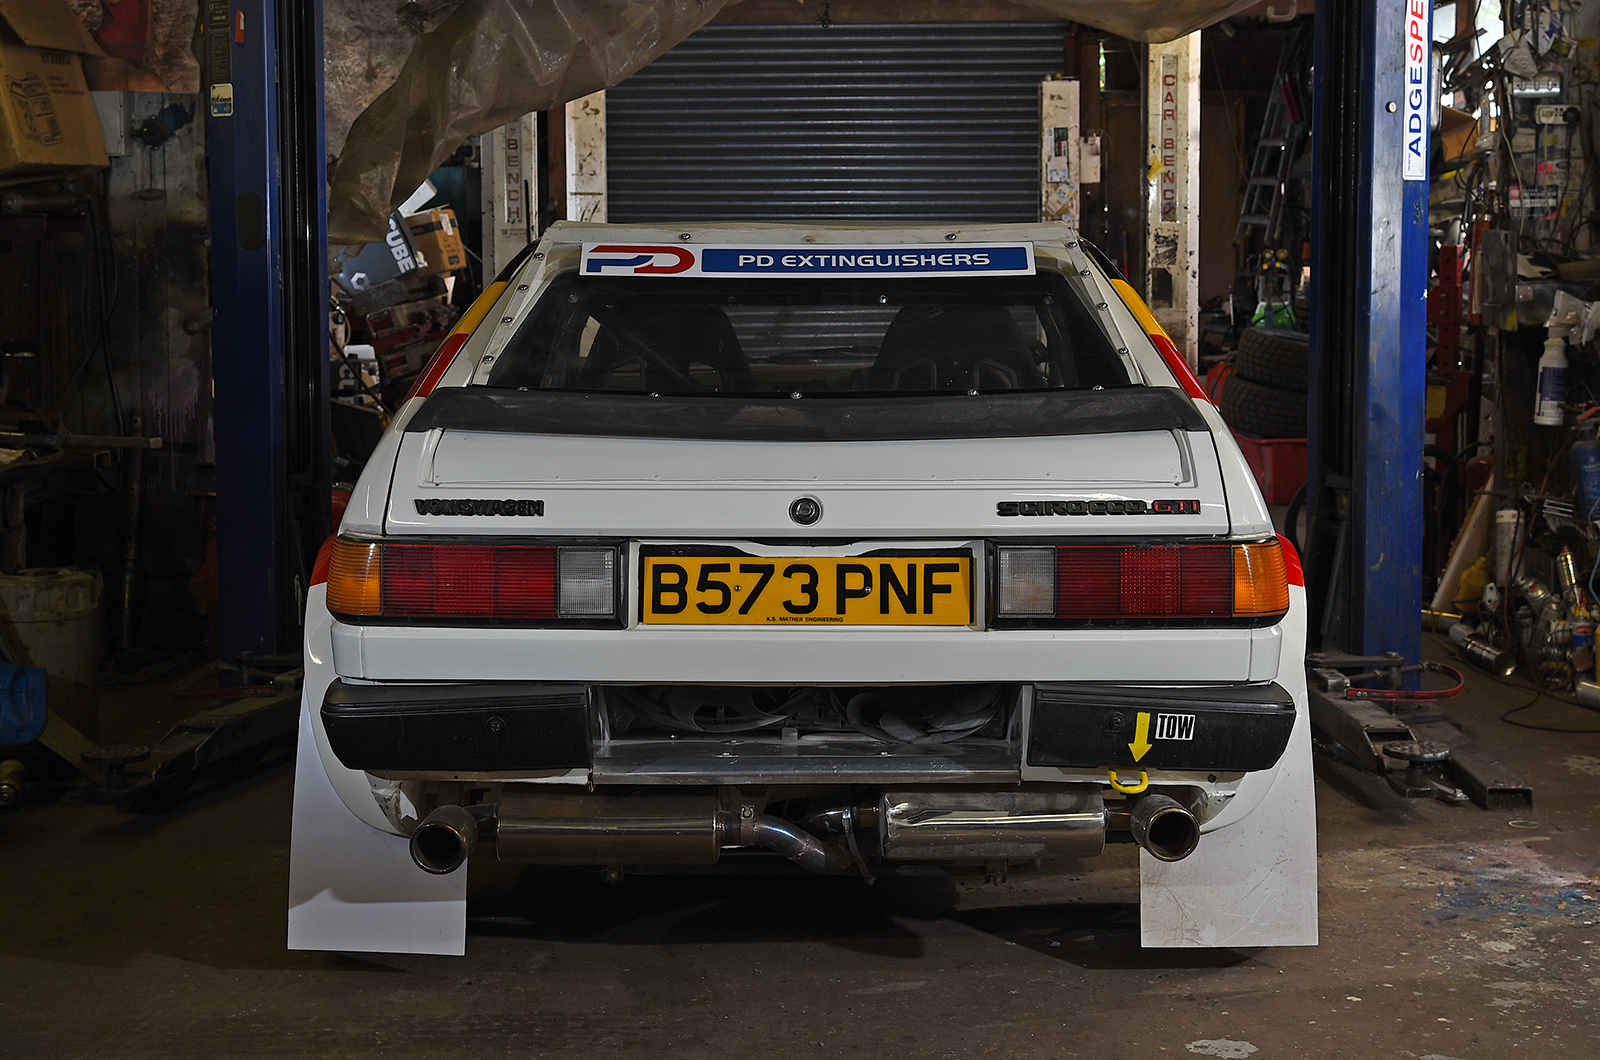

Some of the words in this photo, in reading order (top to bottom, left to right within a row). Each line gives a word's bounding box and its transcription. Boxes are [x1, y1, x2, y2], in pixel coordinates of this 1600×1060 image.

[738, 254, 774, 267] PD
[781, 253, 991, 267] EXTINGUISHERS
[414, 499, 544, 517] VOLKSWAGEN
[996, 500, 1148, 516] SCIROCCO
[1152, 500, 1200, 515] GTI
[651, 563, 819, 615] B573
[836, 563, 960, 615] PNF
[1158, 714, 1194, 739] TOW
